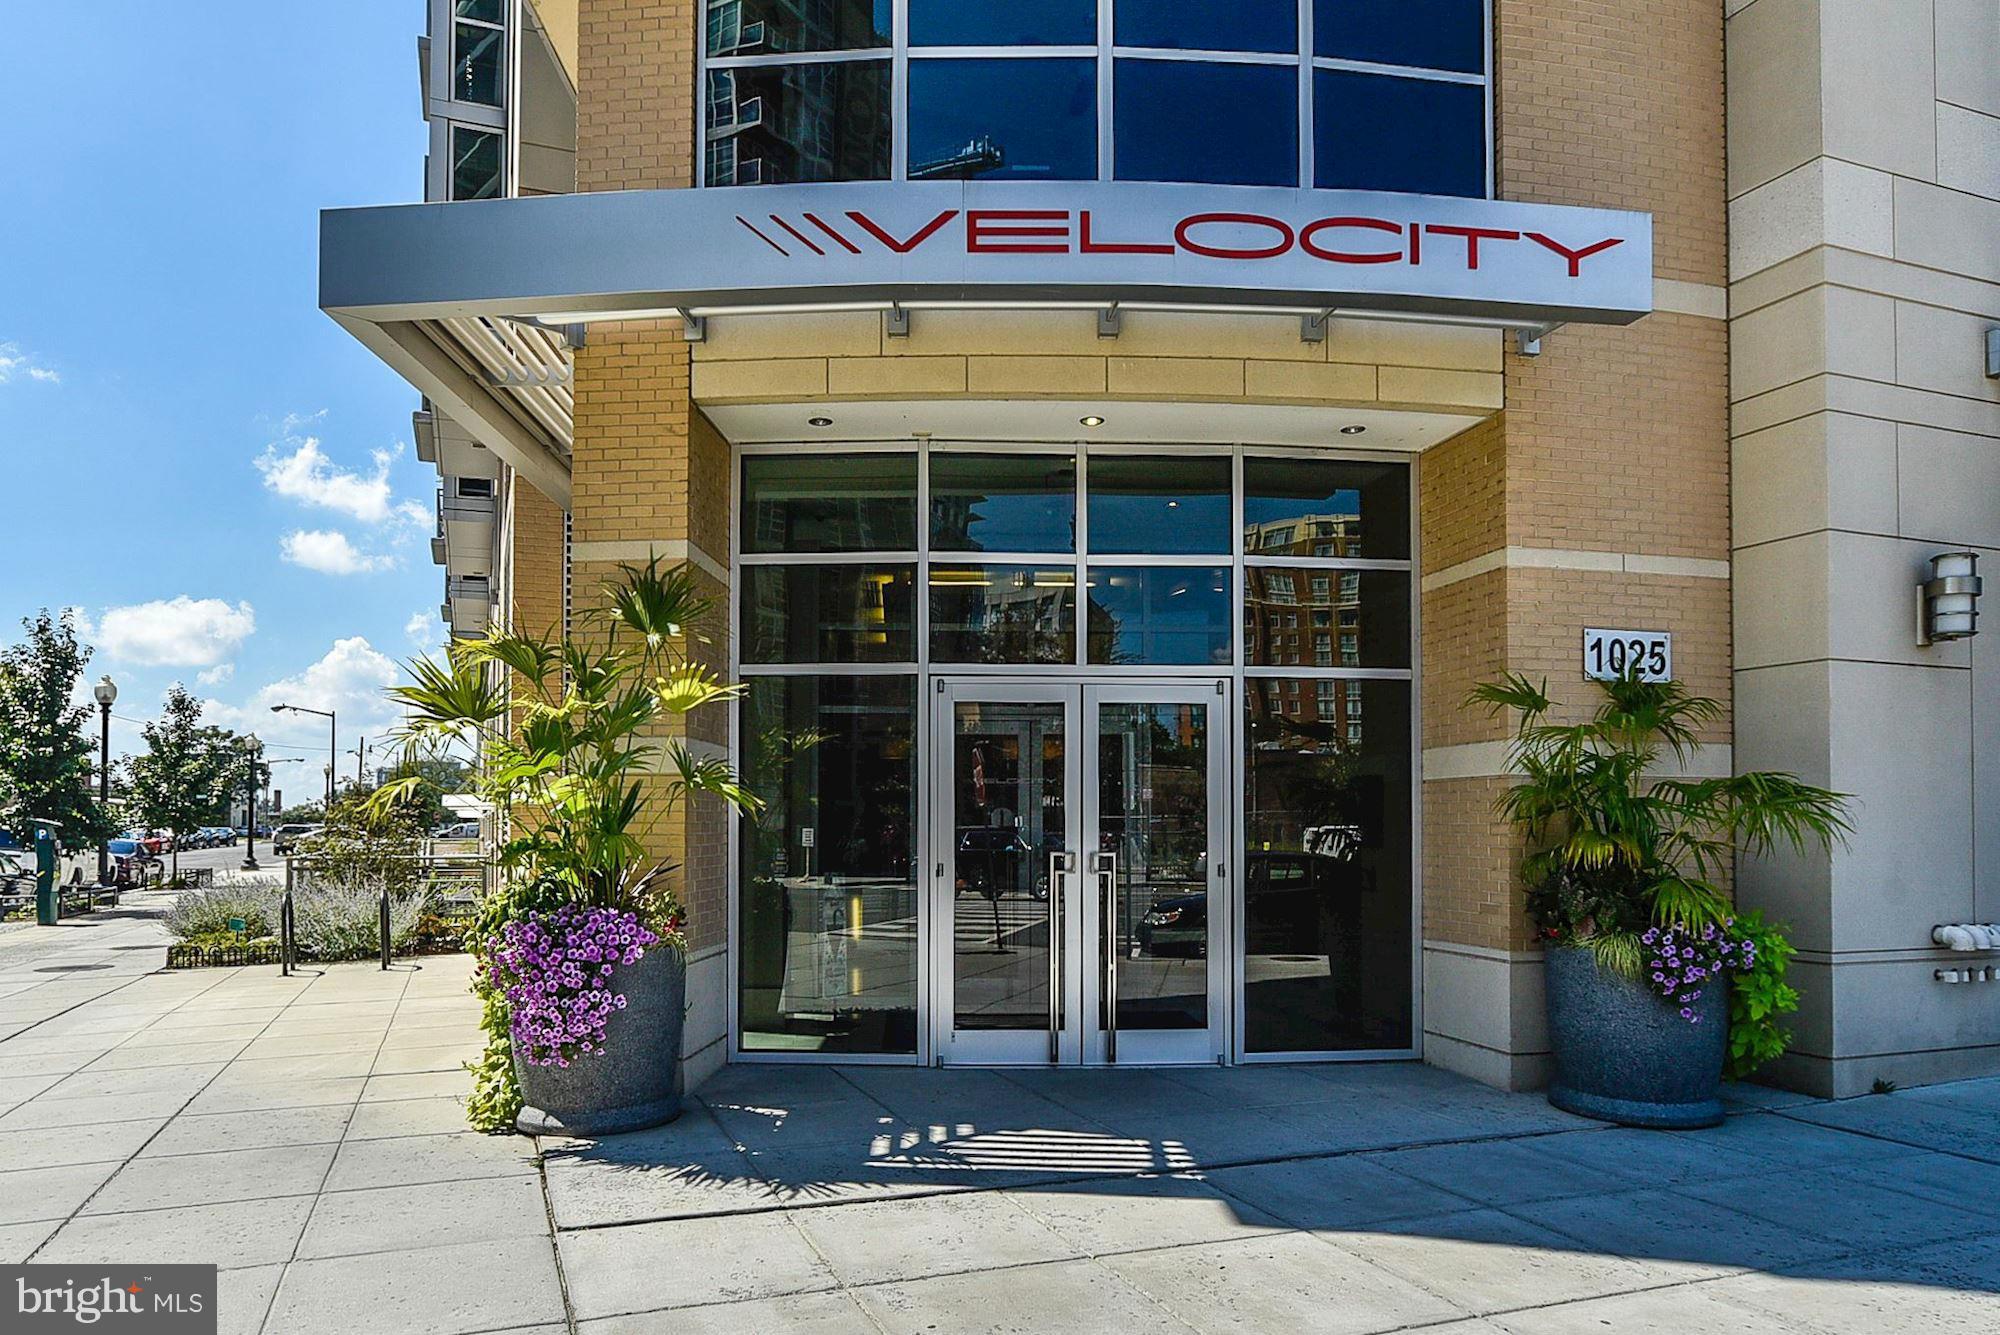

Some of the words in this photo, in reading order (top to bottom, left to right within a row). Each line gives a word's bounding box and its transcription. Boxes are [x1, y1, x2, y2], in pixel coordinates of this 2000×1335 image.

[844, 209, 1625, 277] VELOCITY
[1590, 637, 1666, 676] 1025
[969, 777, 1057, 785] ELOCITY
[38, 829, 47, 840] P
